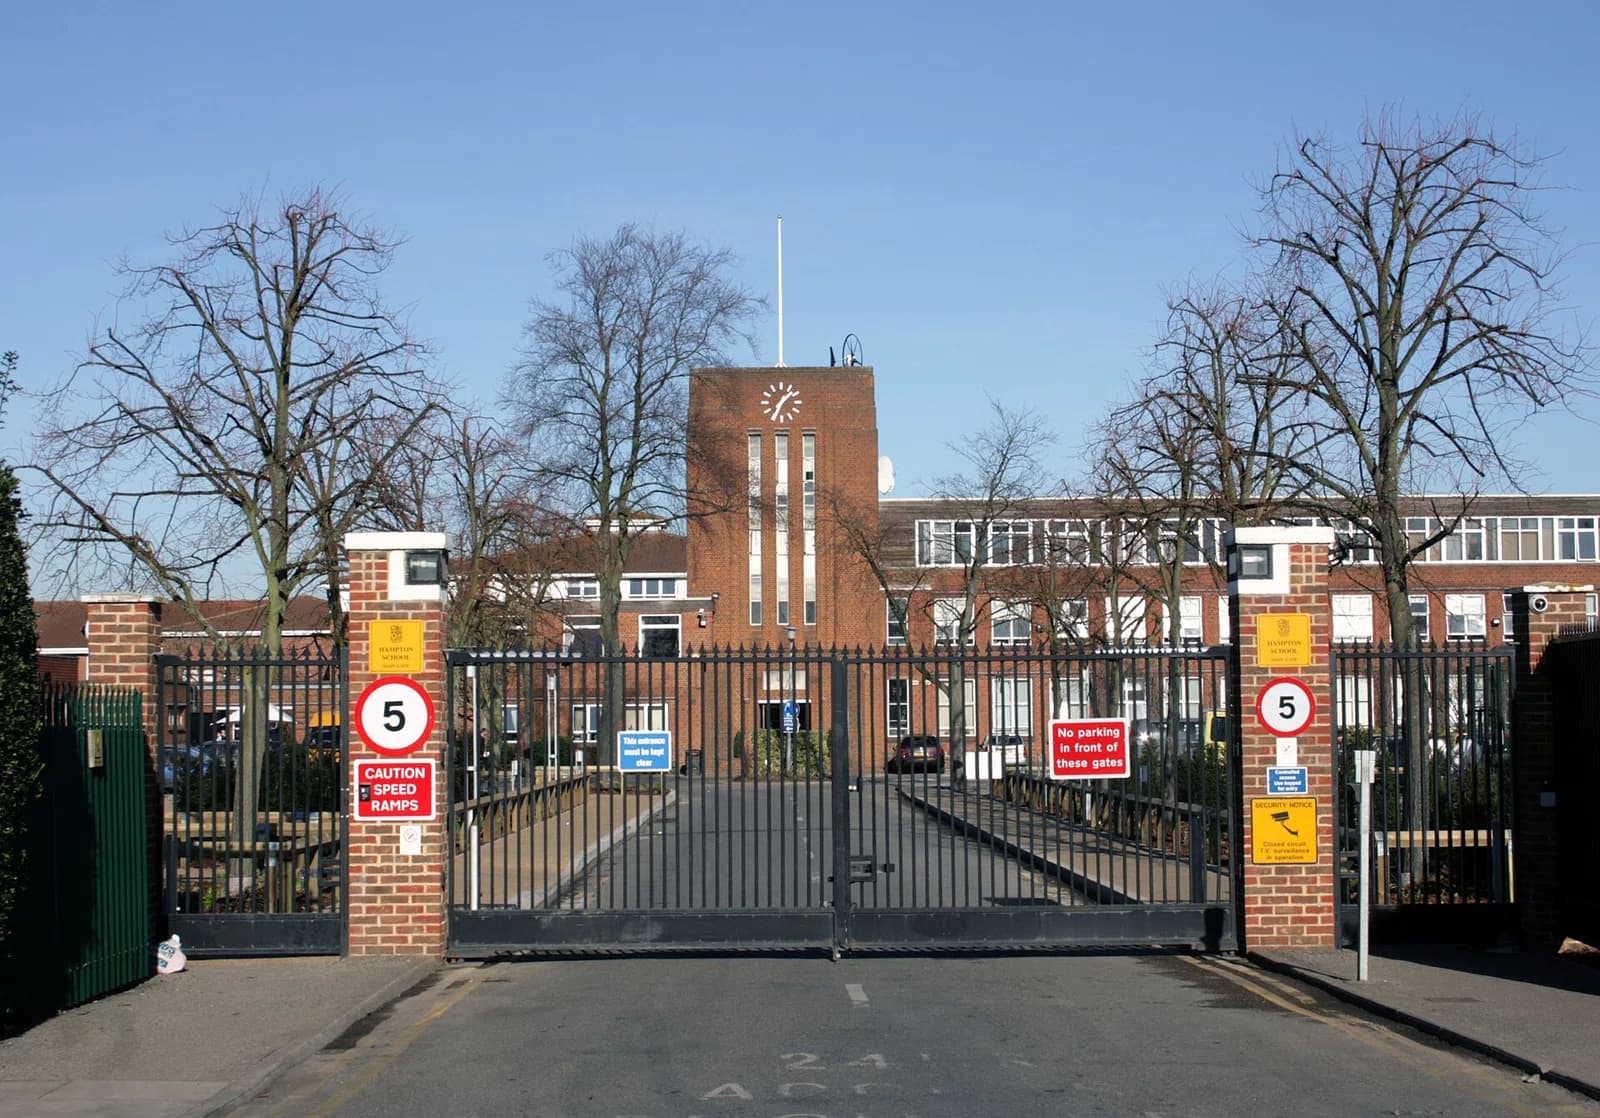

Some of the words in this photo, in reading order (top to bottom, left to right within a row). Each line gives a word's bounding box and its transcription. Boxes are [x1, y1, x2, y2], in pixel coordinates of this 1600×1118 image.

[1279, 696, 1296, 719] 5
[383, 700, 406, 732] 5
[1057, 728, 1074, 738] No
[1078, 727, 1120, 739] parking
[623, 737, 637, 745] This
[637, 737, 665, 745] entrance
[624, 748, 640, 756] must
[641, 748, 649, 756] be
[650, 748, 665, 757] kept
[1060, 743, 1070, 753] in
[1074, 742, 1103, 753] front
[1106, 742, 1118, 752] of
[635, 759, 653, 767] clear
[1056, 758, 1088, 768] these
[1092, 757, 1123, 769] gates
[364, 767, 426, 779] CAUTION
[373, 784, 417, 795] SPEED
[371, 800, 419, 811] RAMPS
